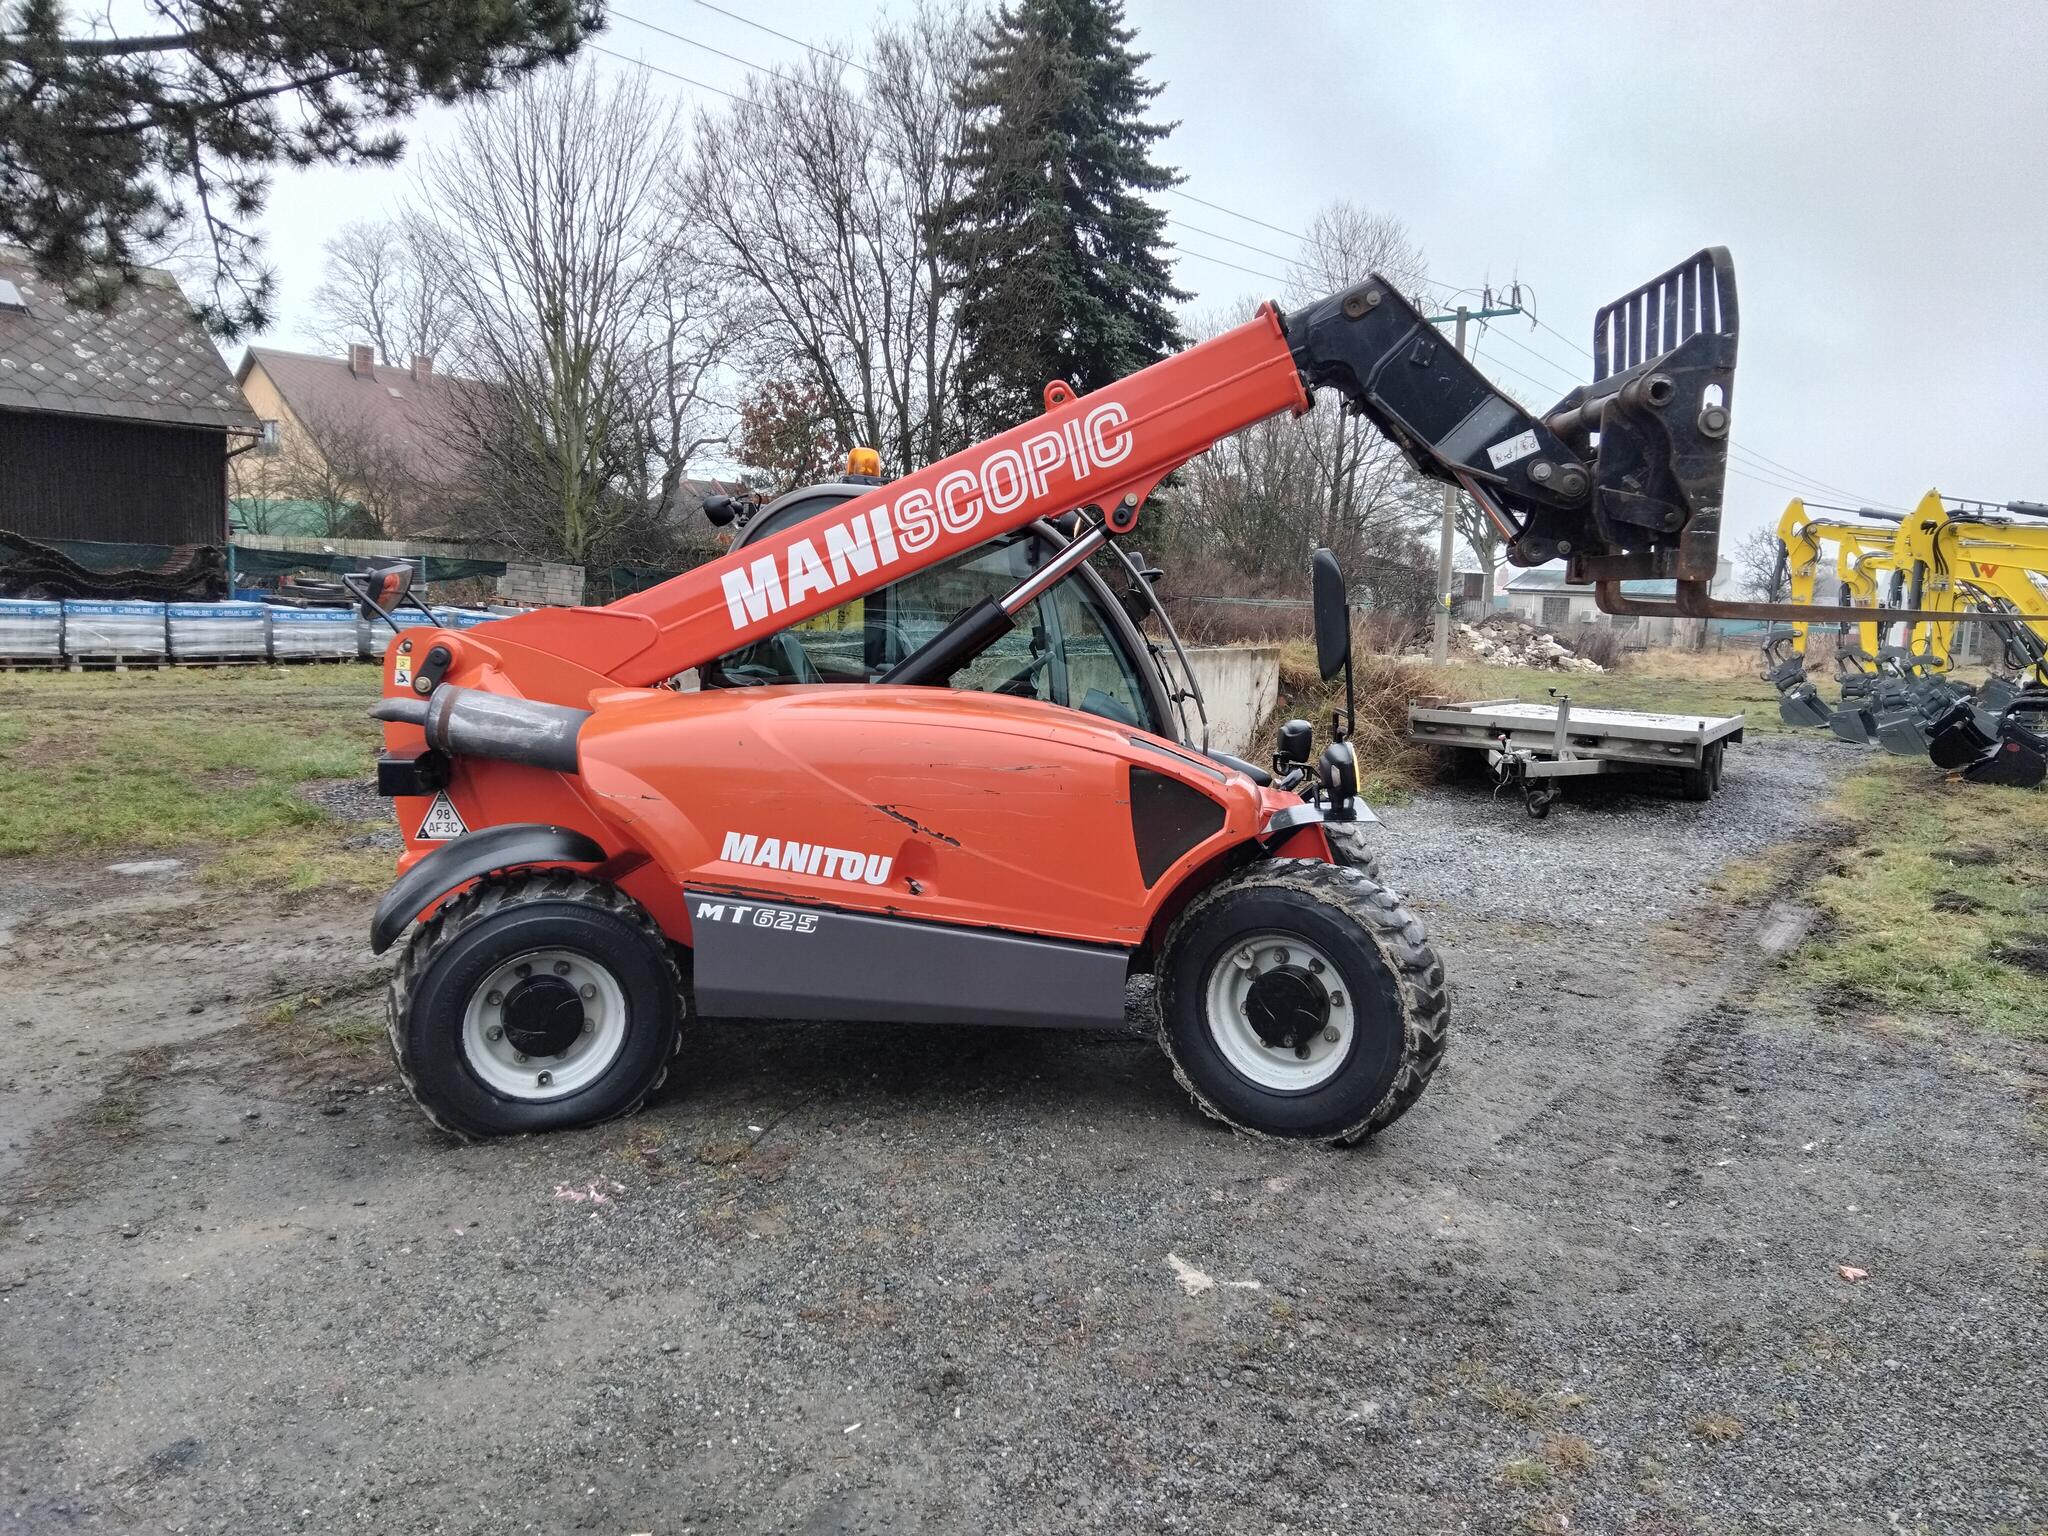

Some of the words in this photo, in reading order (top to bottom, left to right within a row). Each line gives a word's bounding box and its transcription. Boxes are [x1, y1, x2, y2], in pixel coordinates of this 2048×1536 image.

[720, 401, 1133, 631] MANISCOPIC
[429, 822, 458, 833] AF3C
[436, 809, 451, 820] 98
[720, 831, 893, 885] MANITOU
[696, 903, 752, 924] MT
[753, 908, 819, 933] 625
